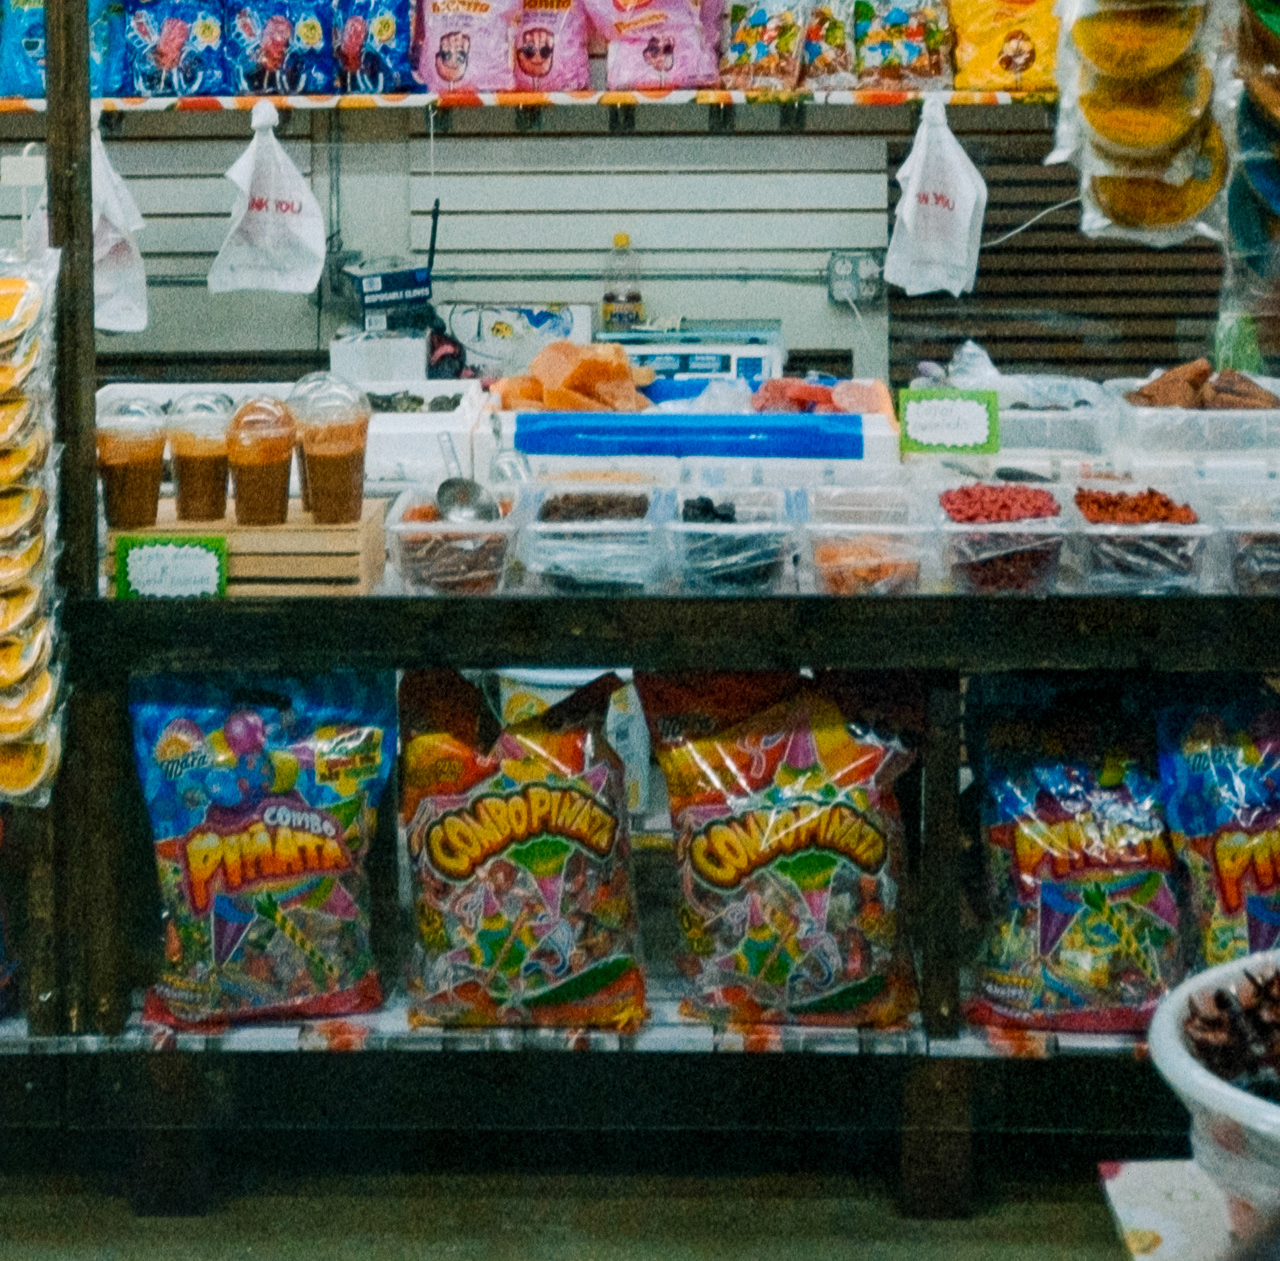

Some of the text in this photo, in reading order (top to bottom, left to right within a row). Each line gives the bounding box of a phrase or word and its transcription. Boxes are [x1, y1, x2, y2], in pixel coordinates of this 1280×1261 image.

[273, 199, 303, 215] YOU
[263, 806, 336, 838] COMBO
[429, 795, 529, 874] COMBO
